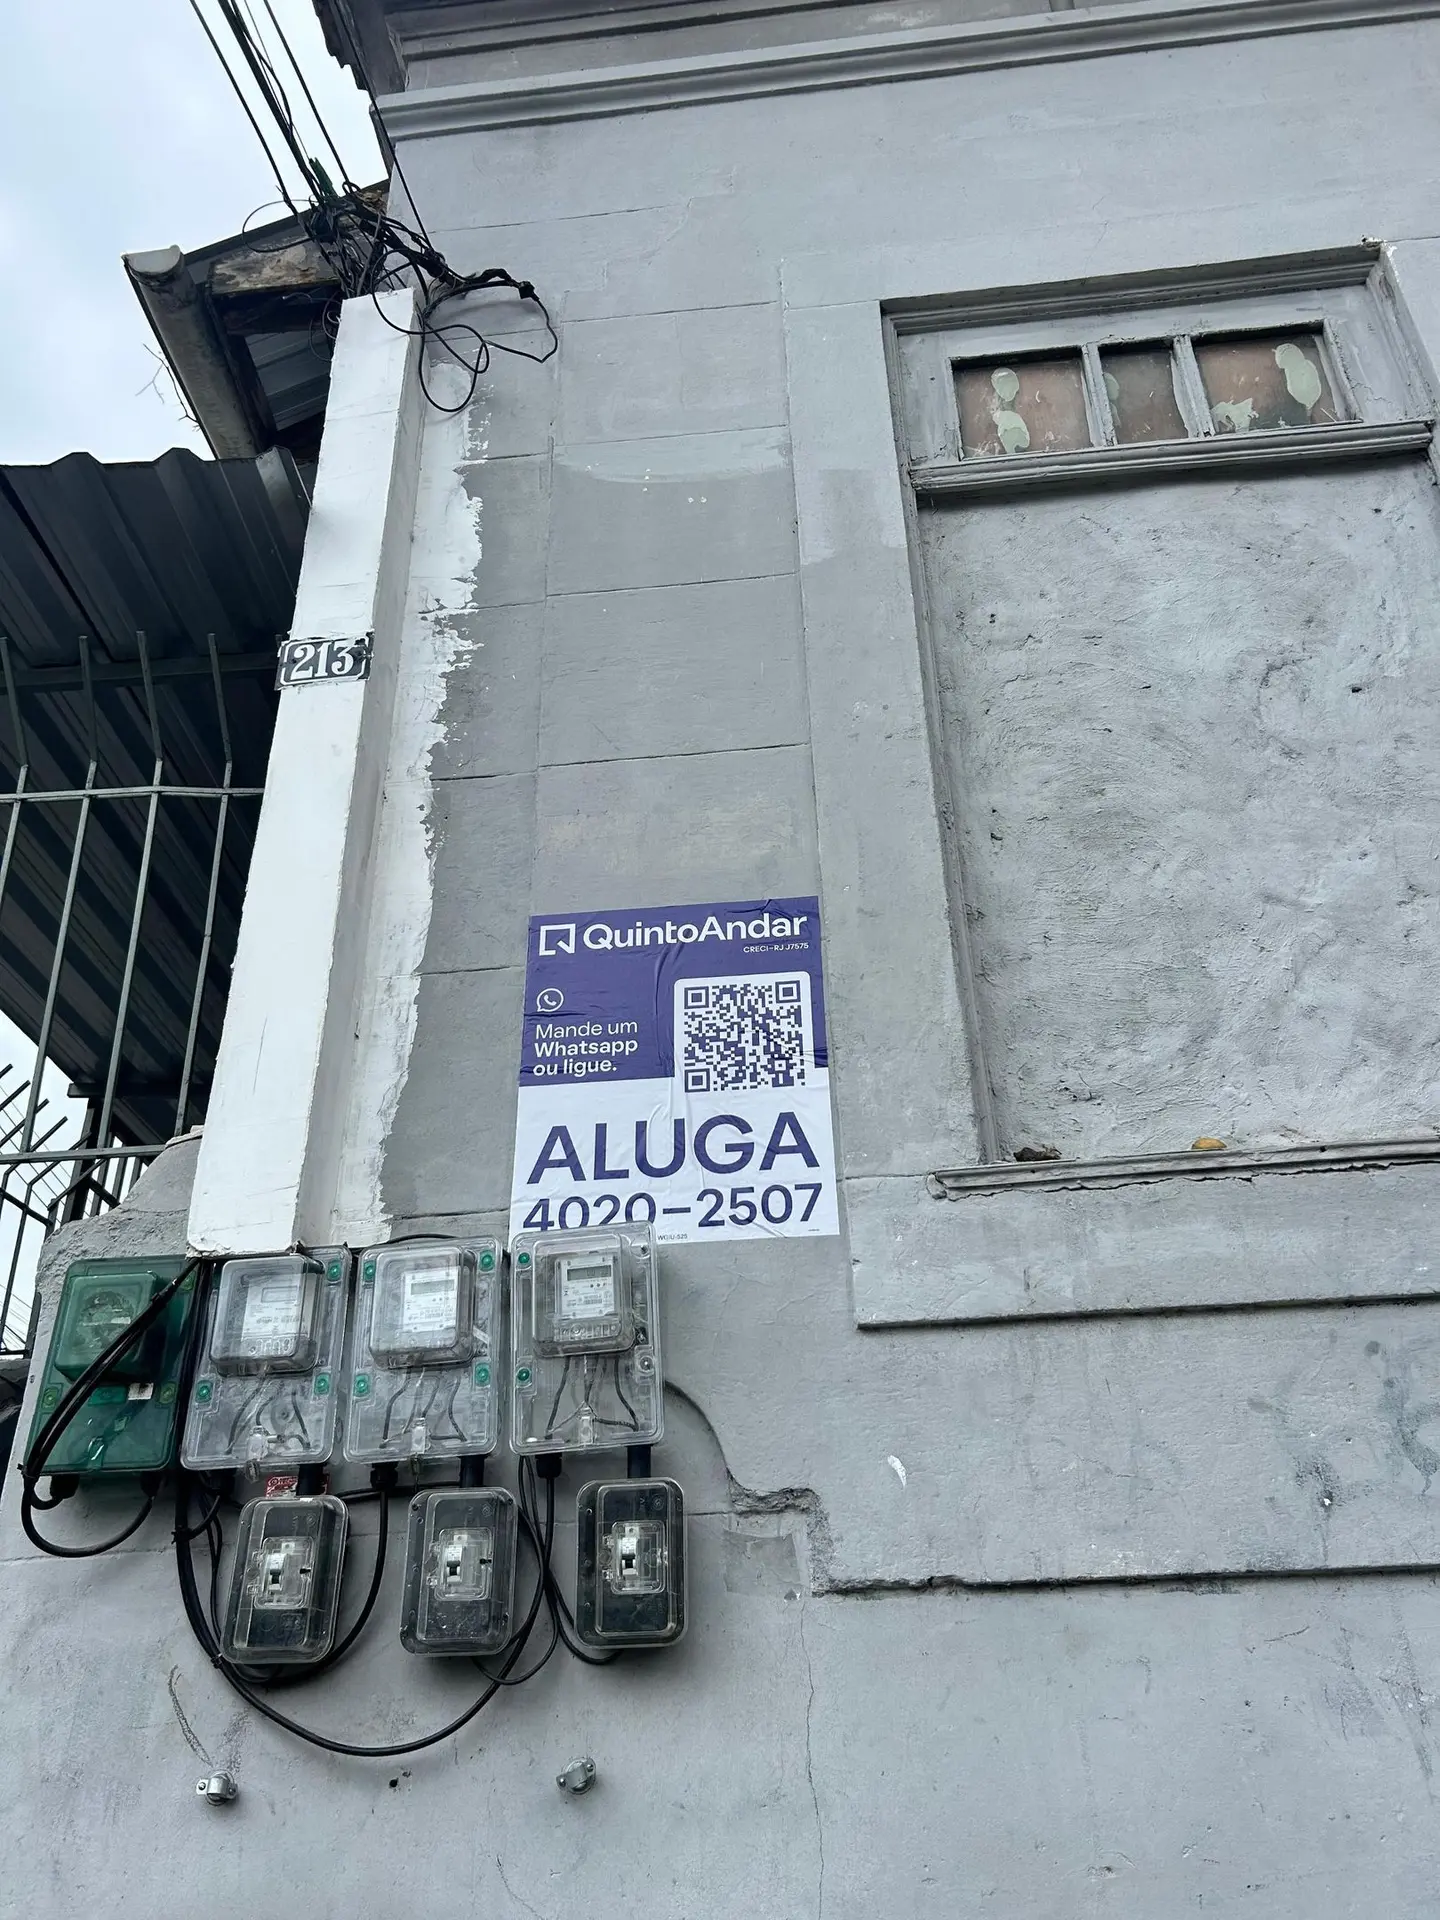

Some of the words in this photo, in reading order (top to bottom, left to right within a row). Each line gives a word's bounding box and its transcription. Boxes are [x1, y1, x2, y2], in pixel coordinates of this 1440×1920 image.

[290, 641, 354, 680] 213
[583, 913, 808, 950] QuintoAndar
[743, 944, 784, 953] CRECI-RJ
[785, 942, 809, 951] J7575
[535, 1021, 602, 1039] Mande
[607, 1021, 638, 1035] um
[534, 1039, 638, 1057] Whatsapp
[532, 1063, 558, 1076] ou
[563, 1058, 617, 1077] ligue.
[526, 1111, 820, 1184] ALUGA
[523, 1183, 823, 1231] 4020-2507
